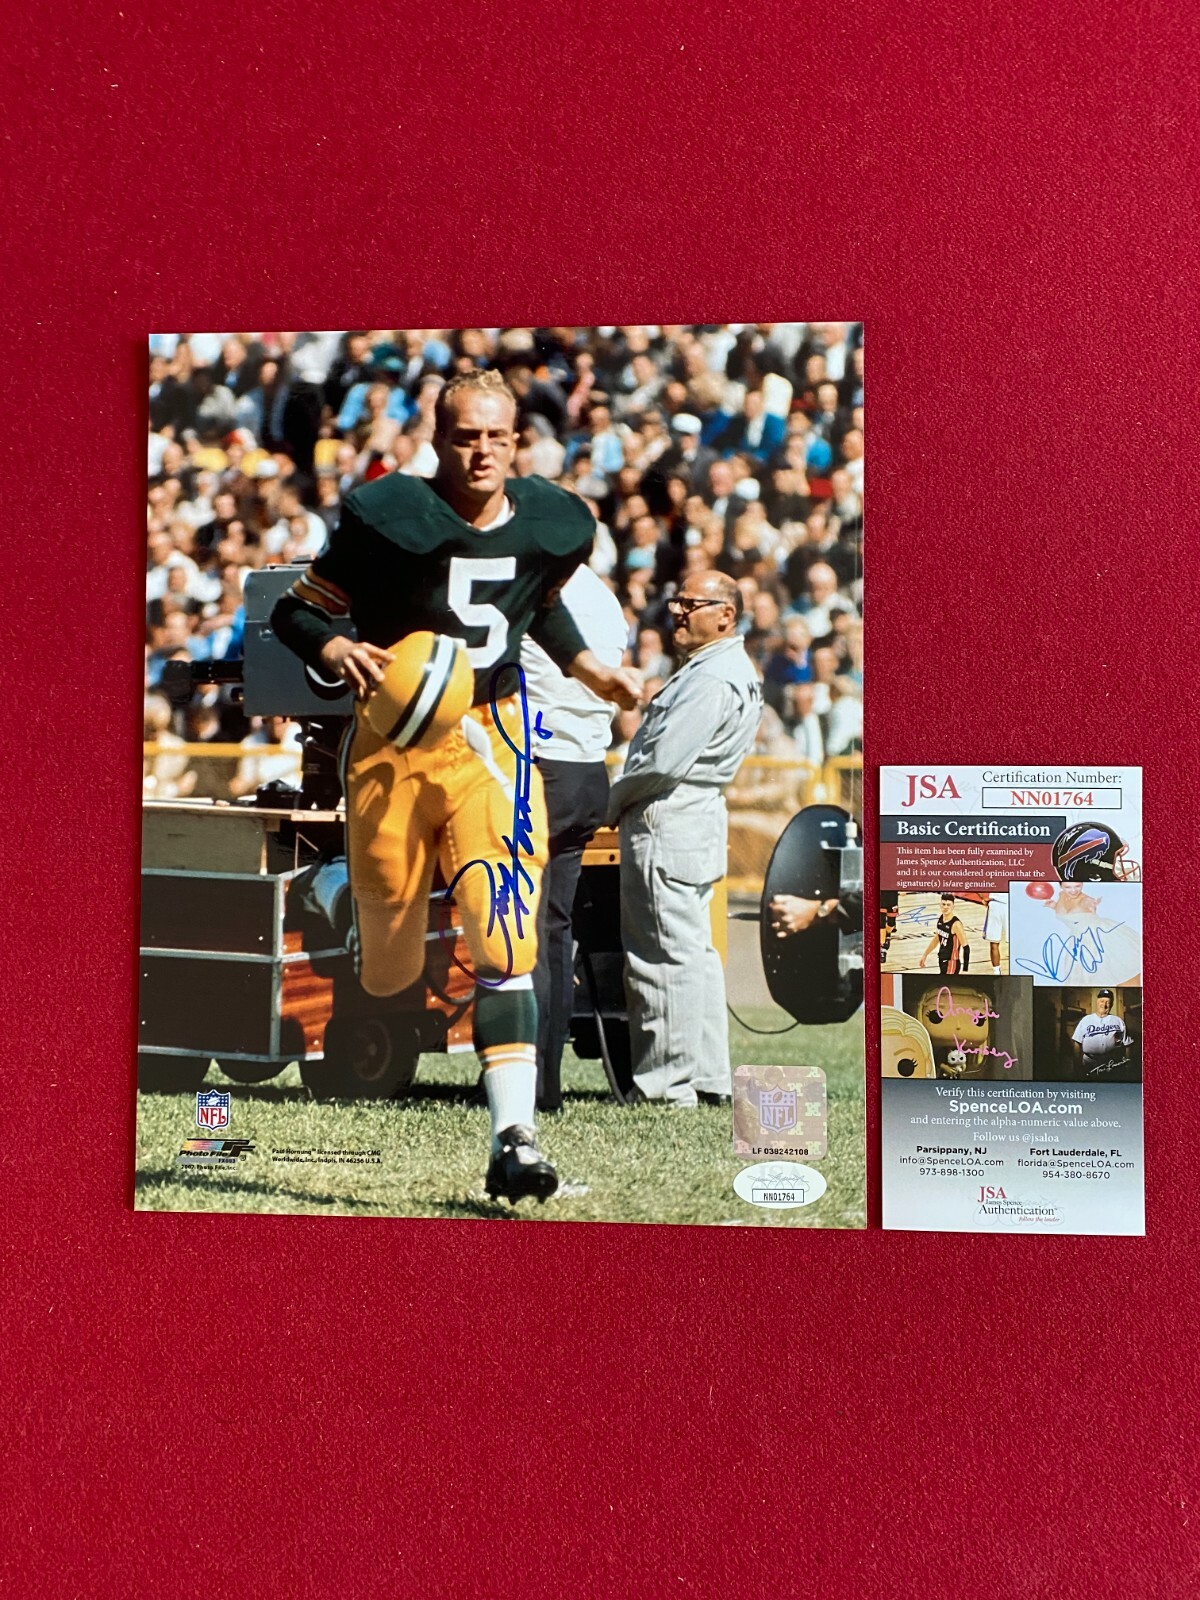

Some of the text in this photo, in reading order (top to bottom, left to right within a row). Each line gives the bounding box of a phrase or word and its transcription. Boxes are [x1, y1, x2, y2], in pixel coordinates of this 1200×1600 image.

[448, 557, 516, 669] 5
[982, 770, 1122, 784] Certification Number:
[901, 774, 962, 807] JSA
[1010, 790, 1094, 806] NN01764
[897, 821, 1051, 837] Basic Certification
[896, 847, 1034, 858] This item has been fully examined by
[896, 857, 1025, 867] James Spence Authentication, LLC
[896, 868, 911, 876] and
[943, 868, 984, 877] considered
[985, 869, 1015, 879] opinion
[896, 879, 997, 890] signature(s) is/are genuine.
[1086, 1024, 1121, 1036] Dodgers
[935, 1086, 1096, 1102] Verify this certification by visiting
[949, 1099, 1083, 1115] SpenceLOA.com
[200, 1107, 227, 1126] NFL
[763, 1106, 793, 1128] NFL
[910, 1114, 1121, 1129] and entering the alpha-numeric value above.
[973, 1131, 1059, 1145] Follow us @jsaloa
[764, 1147, 809, 1156] 038242108
[916, 1146, 987, 1156] Parsippany, NJ
[1029, 1148, 1123, 1158] Fort Lauderdale, FL
[899, 1156, 1004, 1166] info@SpenceLOA.com
[1017, 1158, 1135, 1169] florida@SpenceLOA.com
[919, 1167, 985, 1177] 973-898-1300
[1042, 1170, 1111, 1179] 954-380-8670
[763, 1192, 795, 1202] NN01764
[977, 1185, 1007, 1203] JSA
